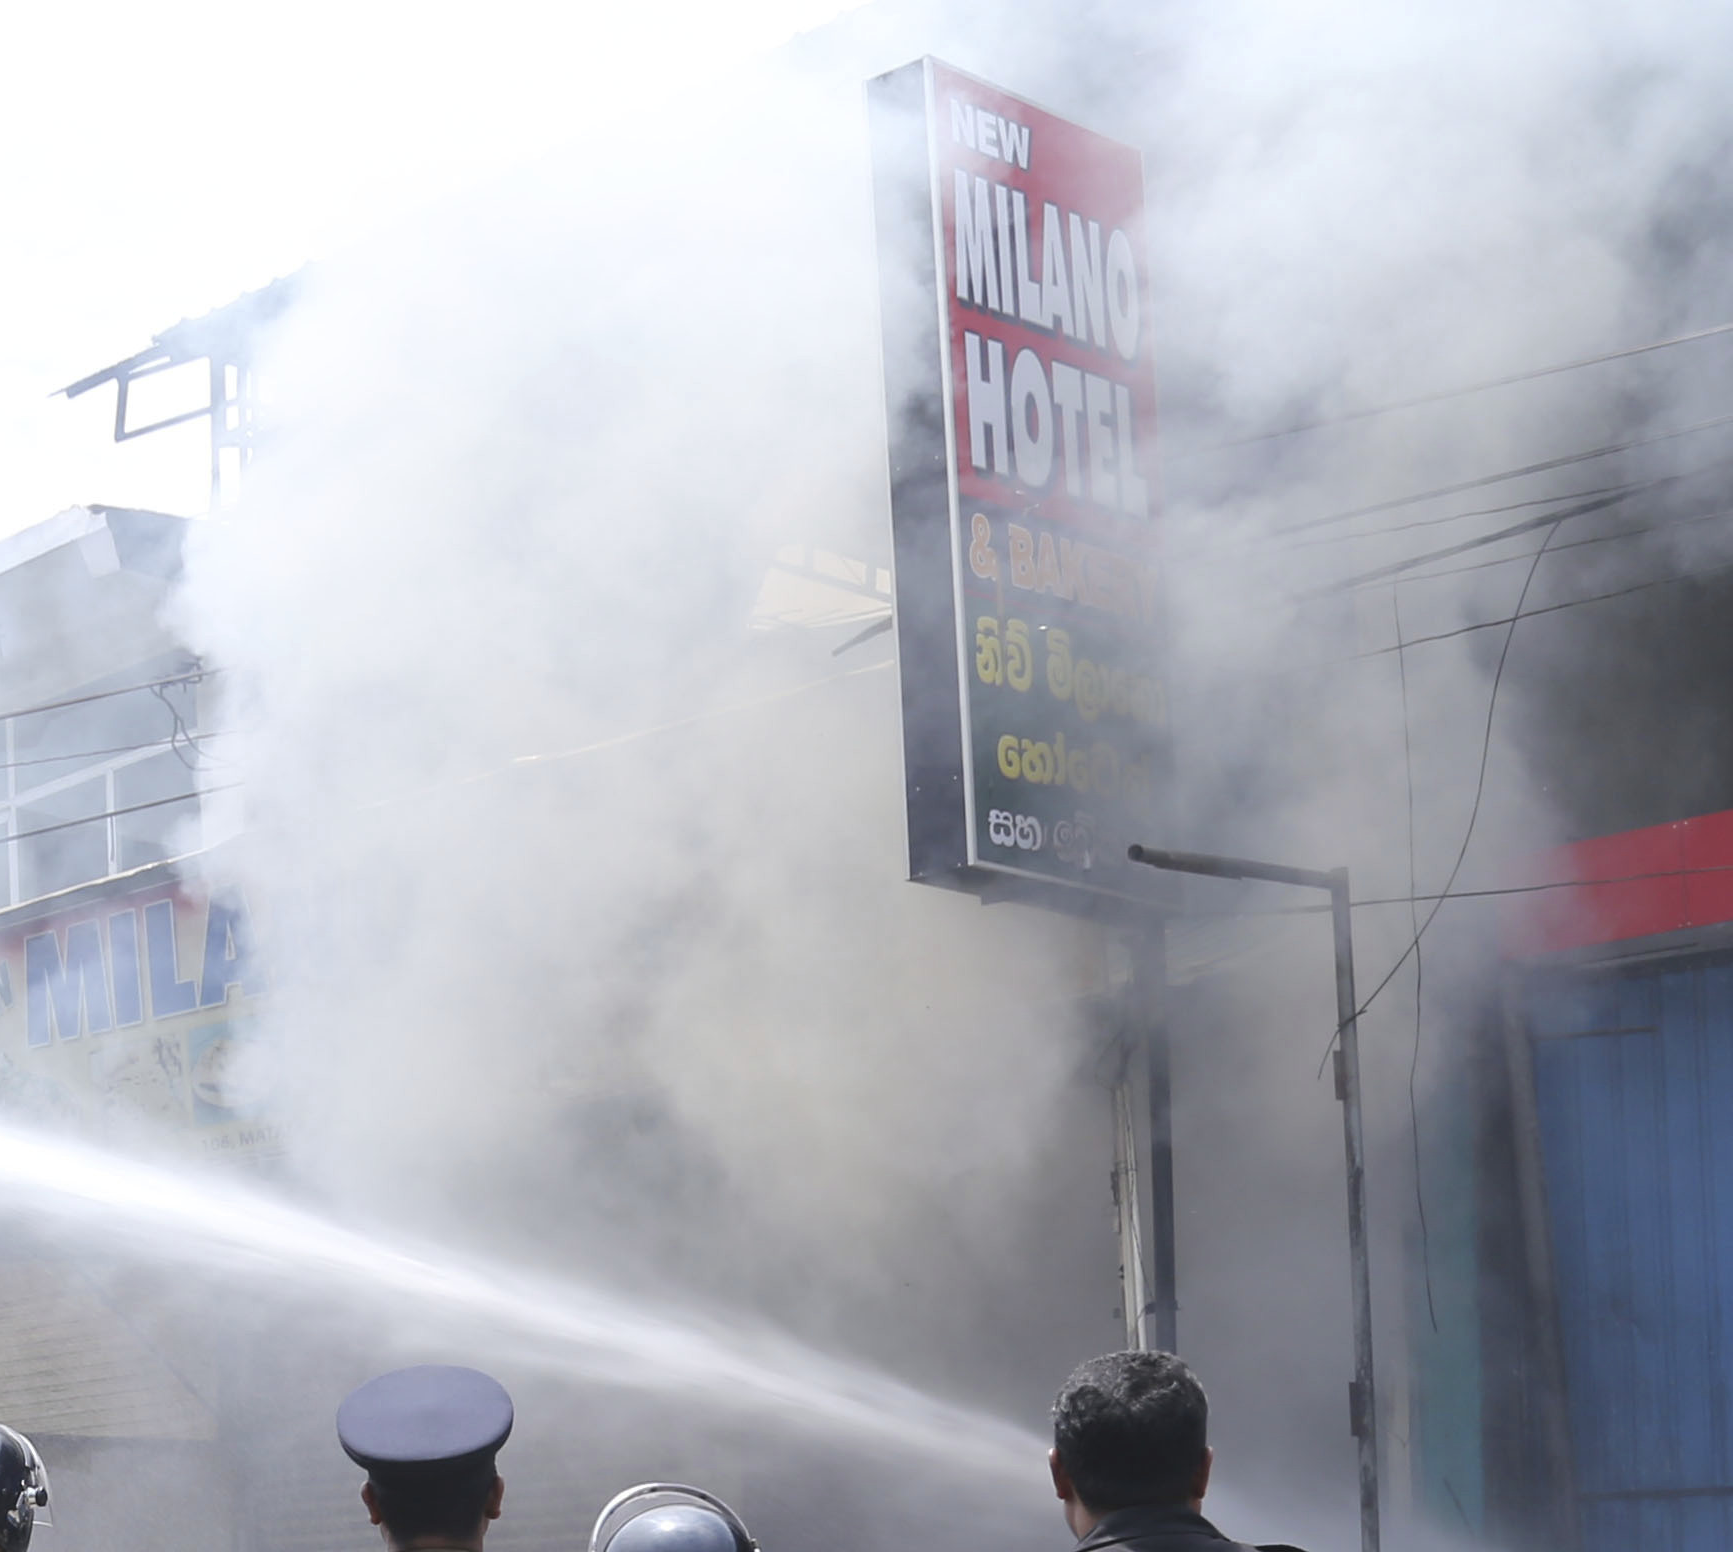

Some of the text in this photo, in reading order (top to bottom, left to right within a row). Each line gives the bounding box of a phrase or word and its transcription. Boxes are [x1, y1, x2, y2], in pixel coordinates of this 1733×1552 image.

[950, 98, 1031, 169] NEW
[954, 168, 1139, 361] MILANO
[964, 332, 1150, 518] HOTEL
